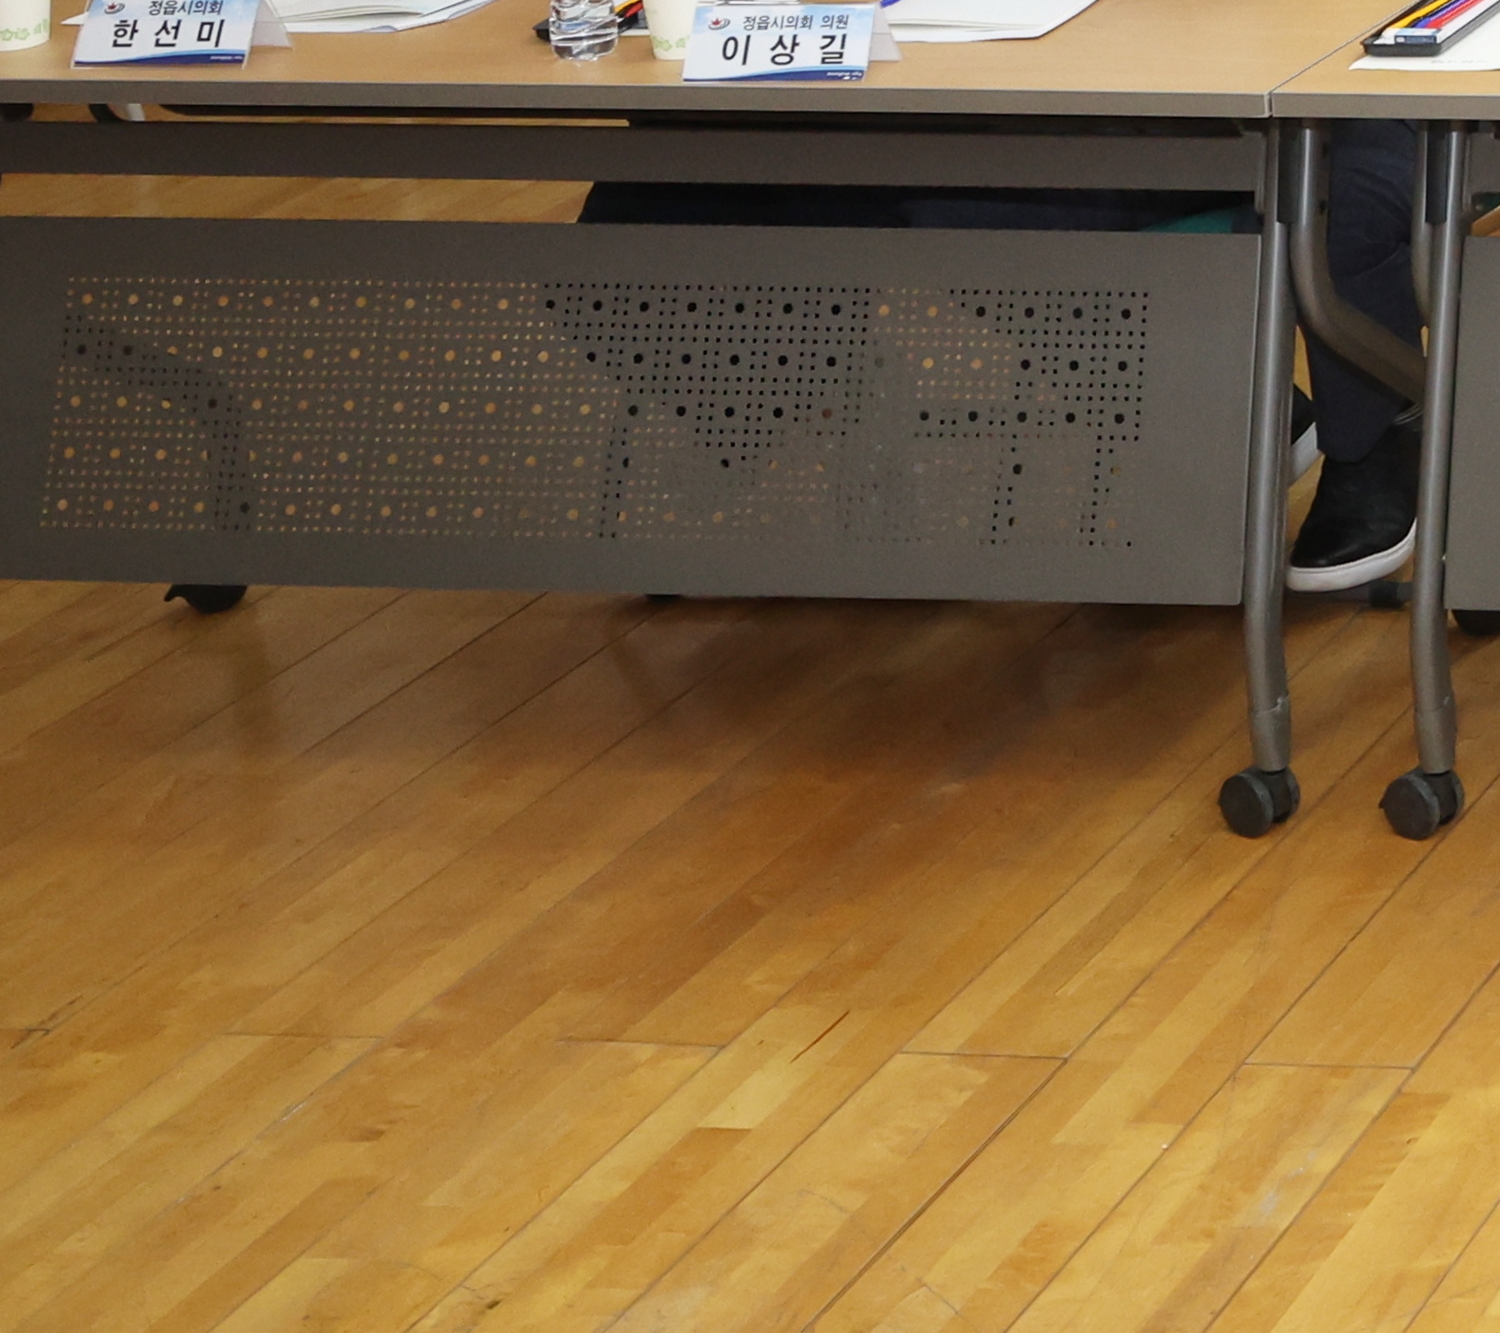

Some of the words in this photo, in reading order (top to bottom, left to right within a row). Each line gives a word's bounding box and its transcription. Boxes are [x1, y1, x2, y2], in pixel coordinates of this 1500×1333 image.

[148, 0, 224, 15] 정읍시의회
[743, 15, 813, 31] 정읍시의회
[820, 14, 849, 30] 의원
